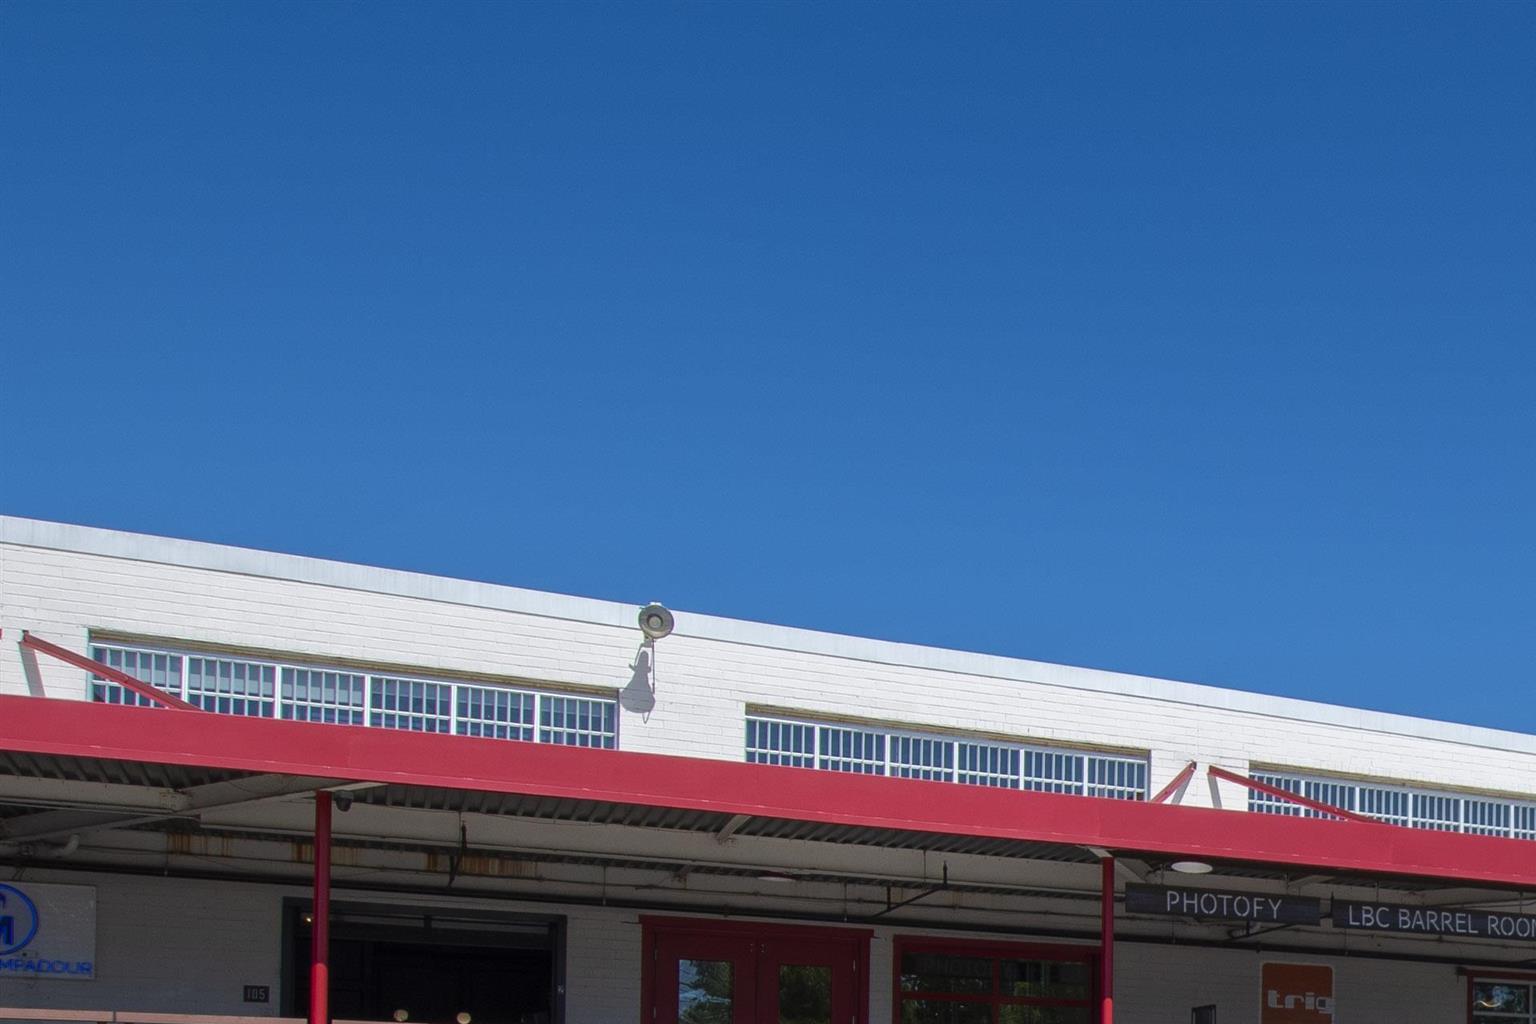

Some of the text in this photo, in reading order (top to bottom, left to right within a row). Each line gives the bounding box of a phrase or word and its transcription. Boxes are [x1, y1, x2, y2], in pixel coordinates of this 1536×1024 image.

[1166, 890, 1283, 920] PHOTOFY
[1349, 905, 1390, 928] LBC
[1398, 908, 1479, 934] BARREL
[1267, 989, 1336, 1014] trig
